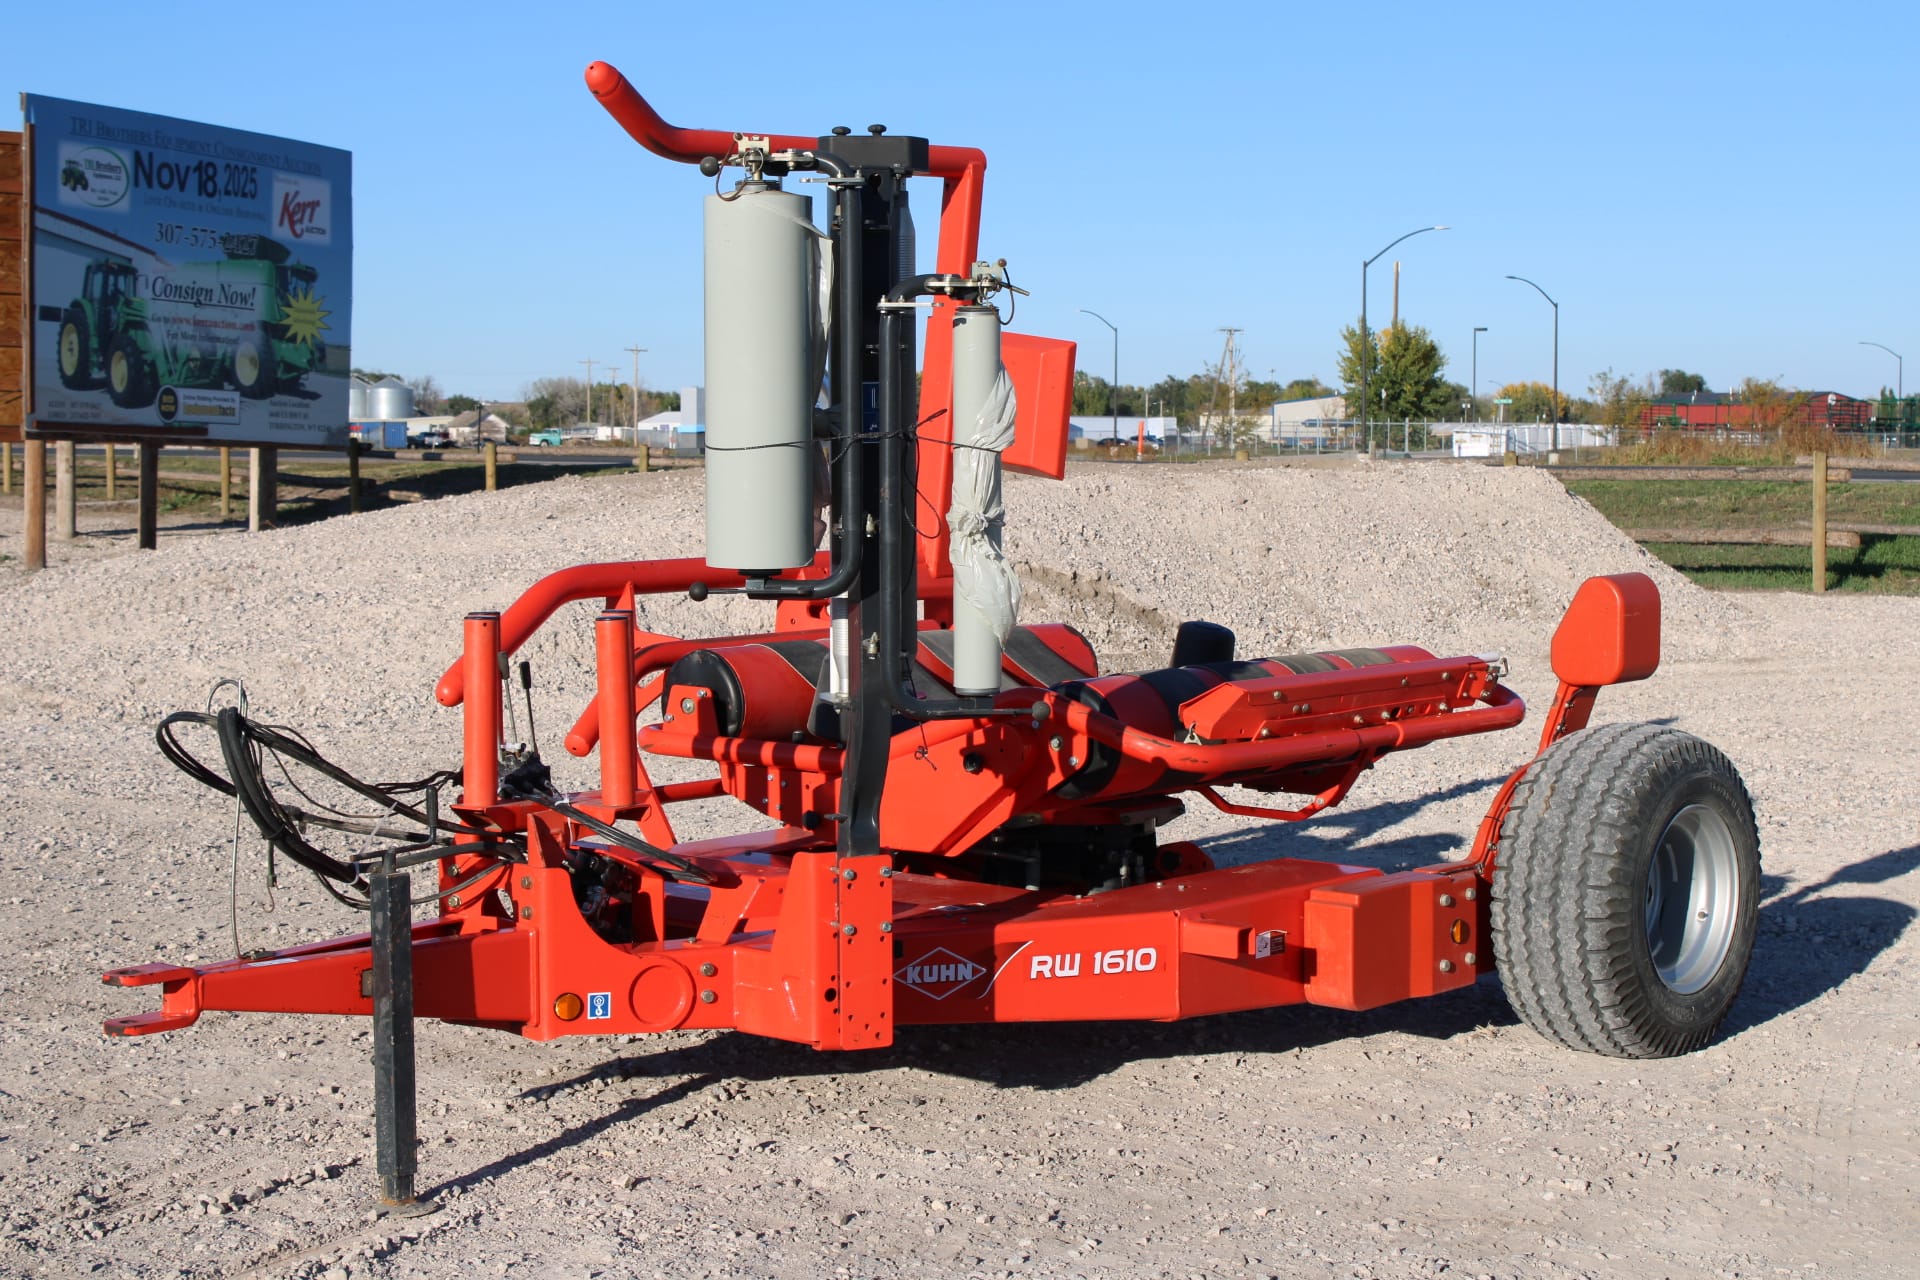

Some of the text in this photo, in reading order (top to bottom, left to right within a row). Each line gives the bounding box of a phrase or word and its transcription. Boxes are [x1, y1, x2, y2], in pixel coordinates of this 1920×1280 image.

[278, 190, 321, 239] Kerr
[151, 275, 257, 308] Consign Now!
[906, 963, 973, 985] KUHN
[1029, 947, 1157, 980] RW 1610
